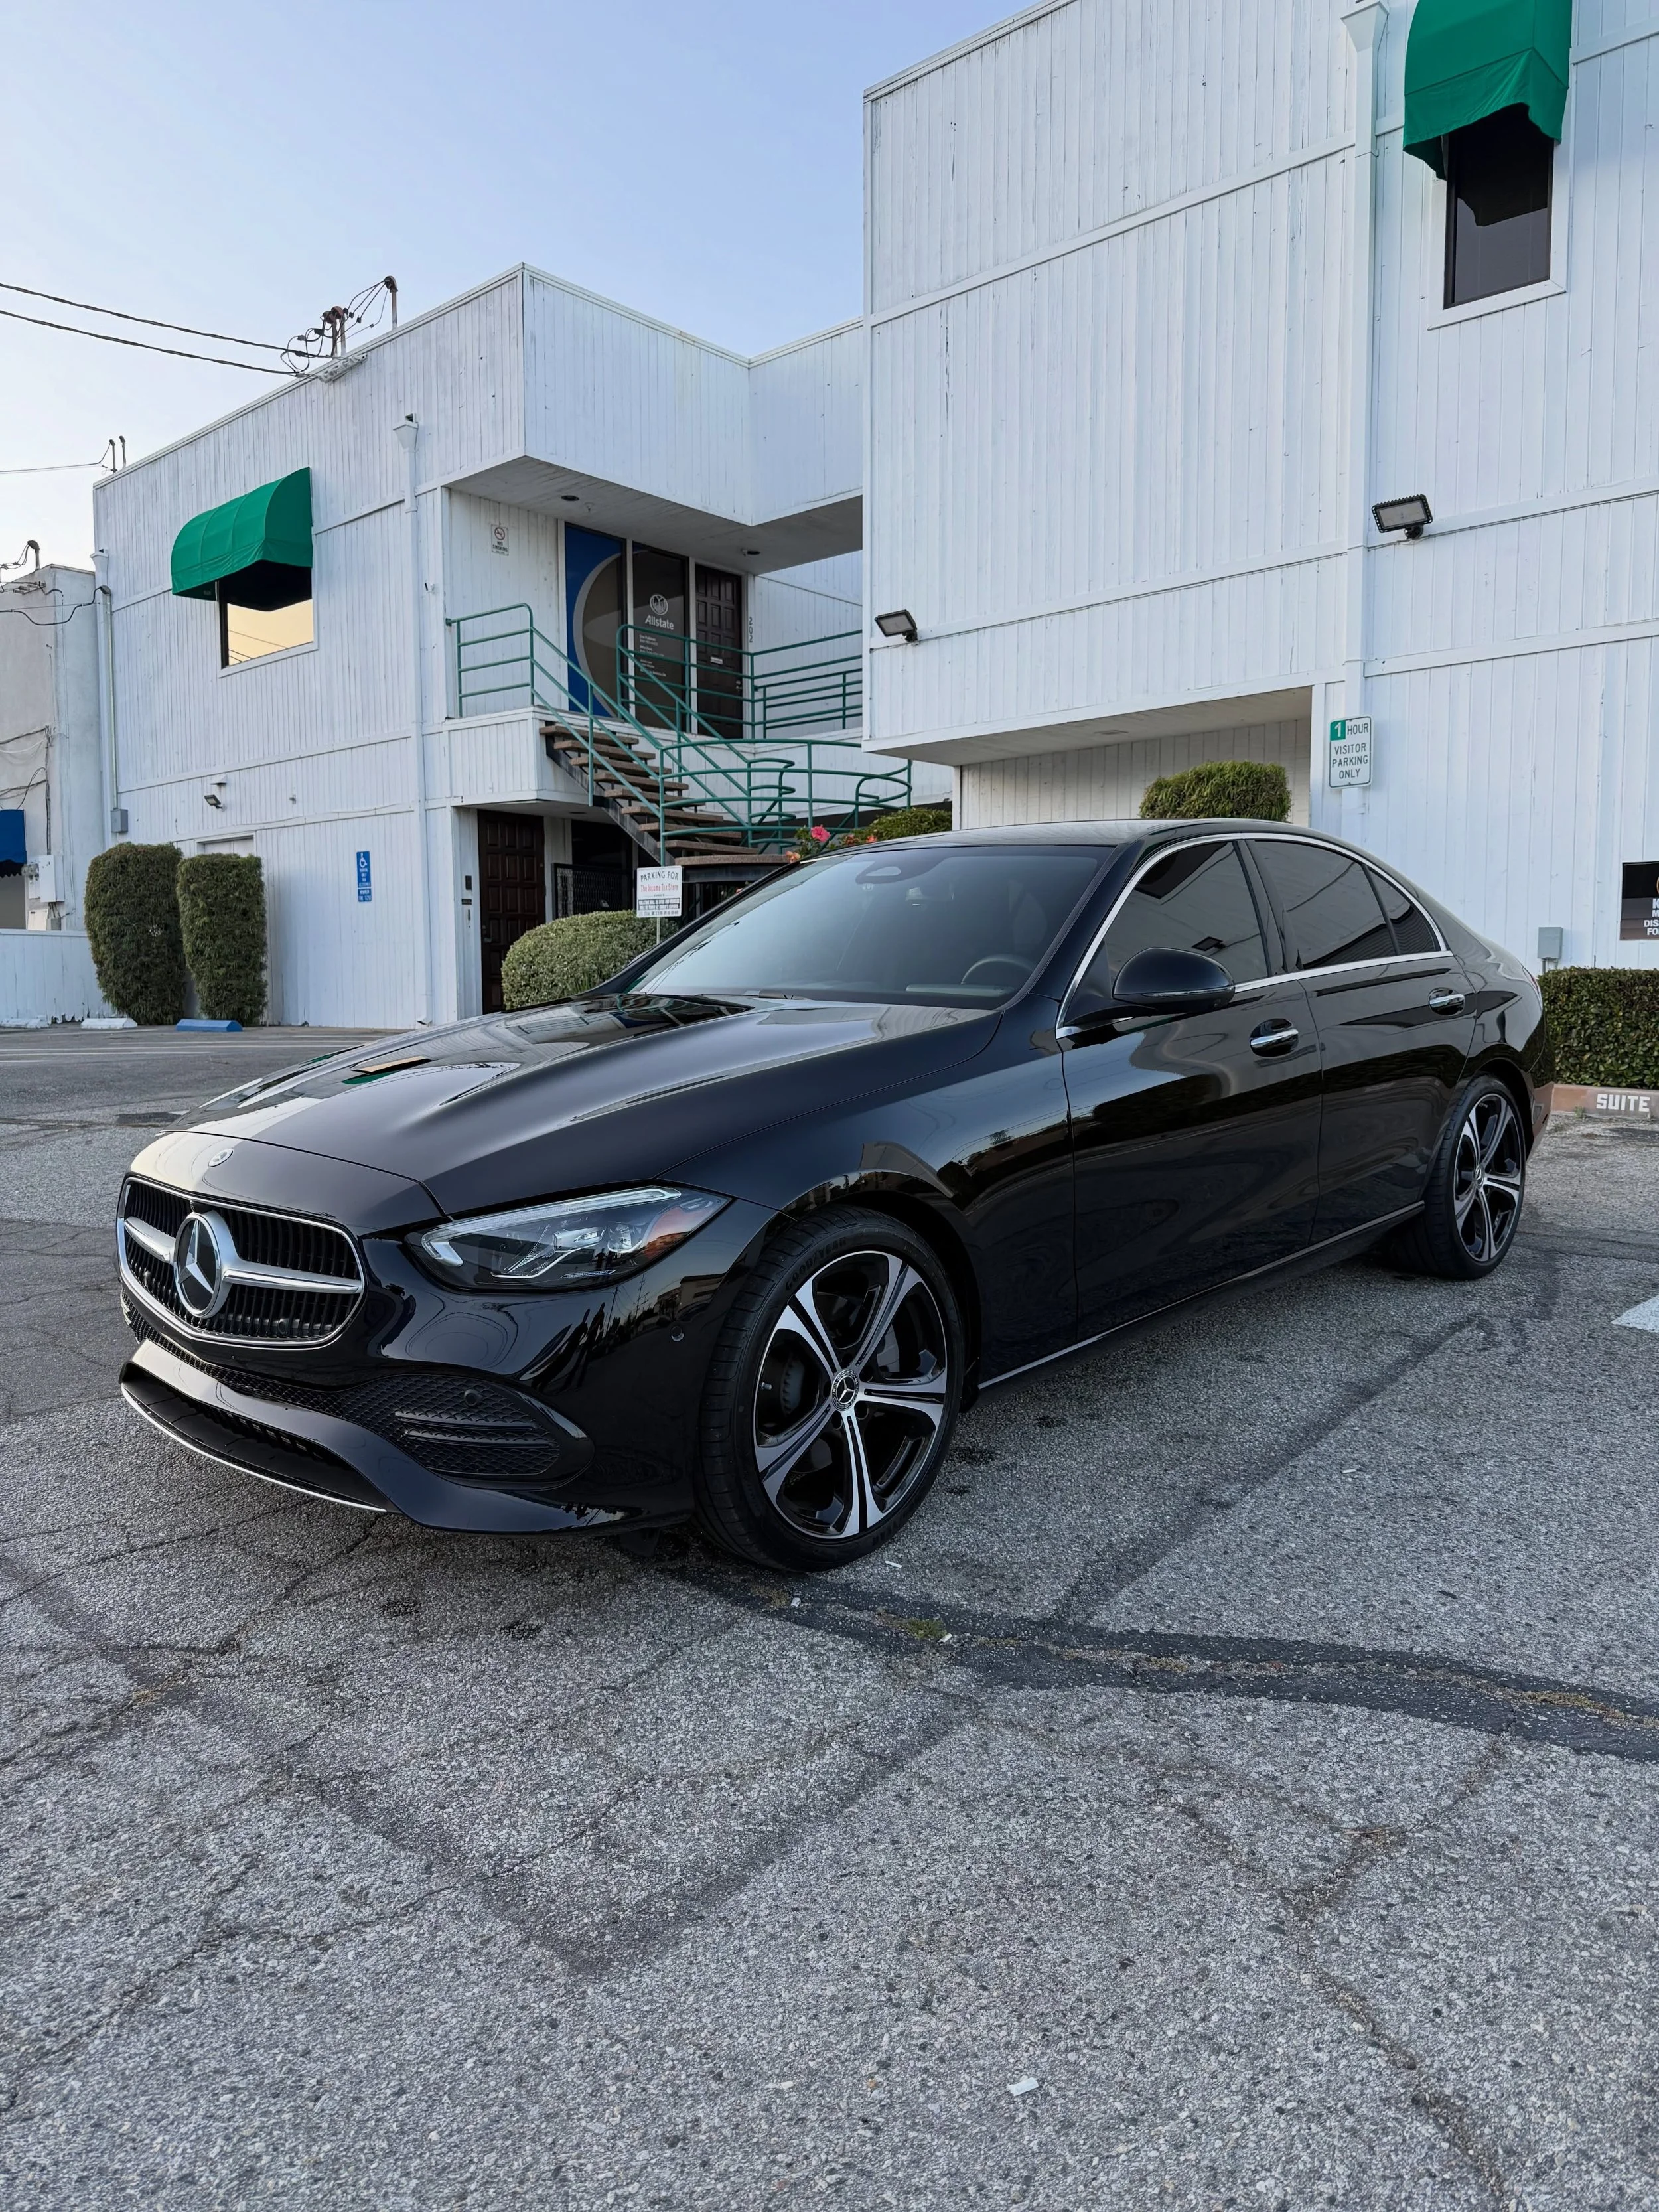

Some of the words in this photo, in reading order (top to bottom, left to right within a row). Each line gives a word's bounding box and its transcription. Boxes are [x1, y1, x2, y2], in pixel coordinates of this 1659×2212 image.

[645, 615, 674, 630] Allstate
[1334, 721, 1342, 737] 1
[1347, 723, 1368, 735] HOUR
[1334, 743, 1366, 755] VISITOR
[1332, 755, 1368, 768] PARKING
[1339, 769, 1360, 779] ONLY
[640, 871, 665, 882] PARKING
[667, 871, 678, 880] FOR
[1597, 1094, 1650, 1112] SUITE
[786, 1236, 847, 1291] GOODYEAR
